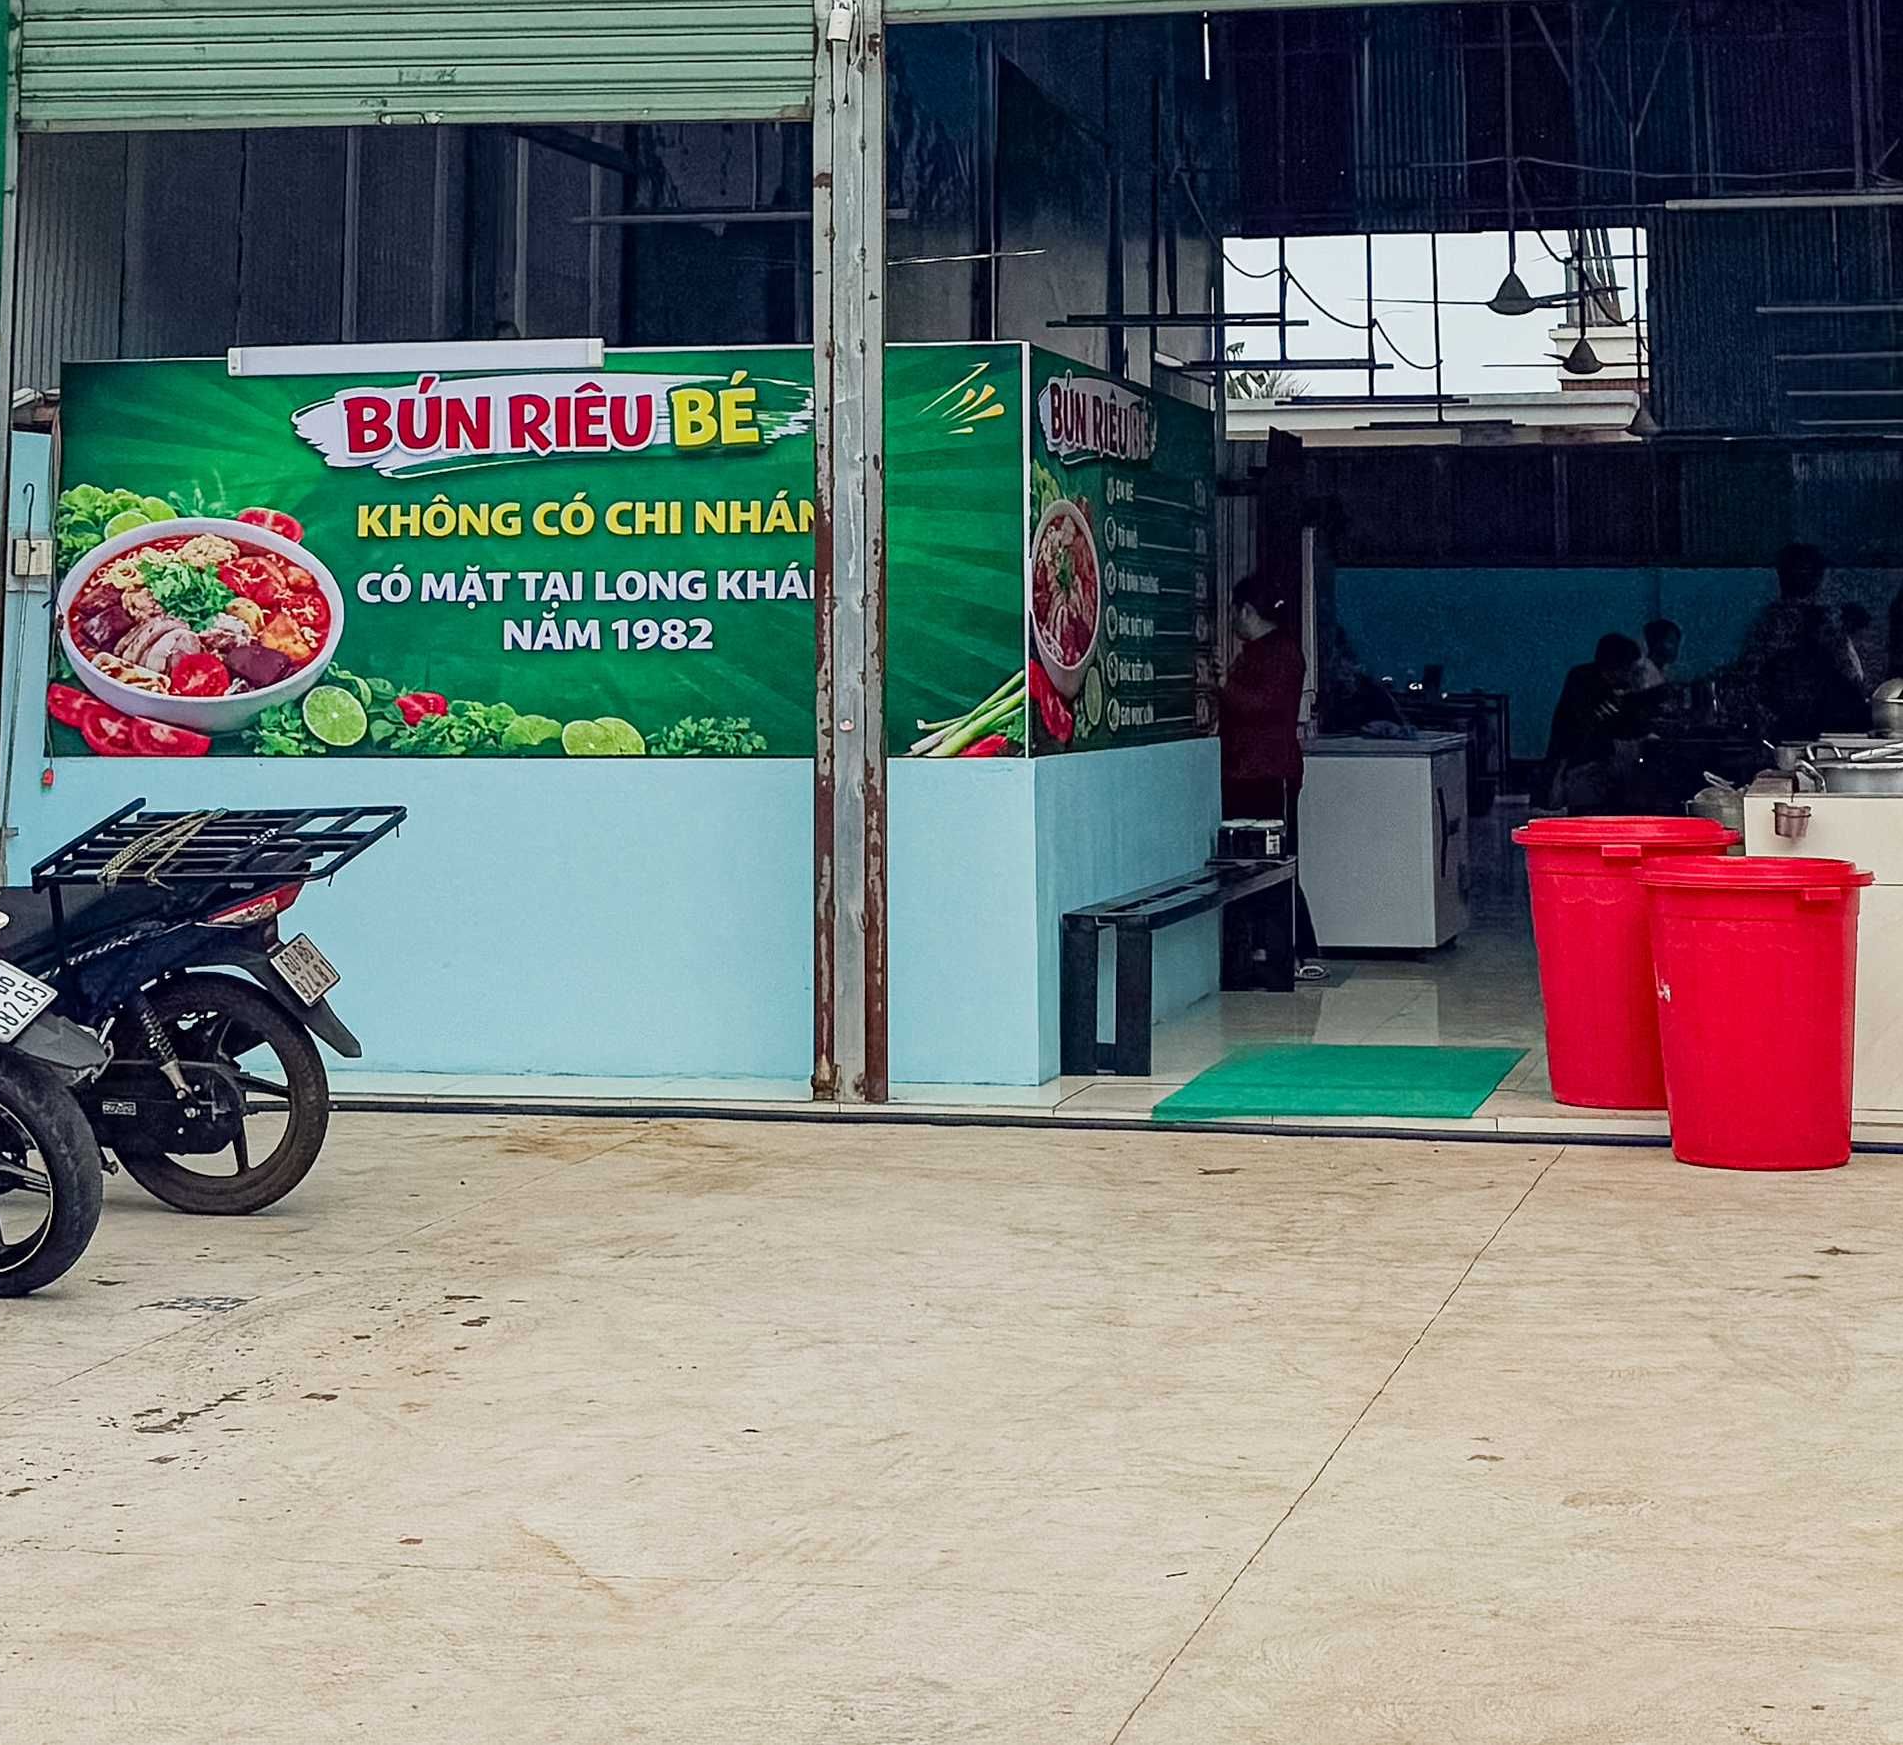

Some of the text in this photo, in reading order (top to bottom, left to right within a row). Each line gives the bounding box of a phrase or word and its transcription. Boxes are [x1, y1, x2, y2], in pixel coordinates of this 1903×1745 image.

[345, 370, 760, 454] BÚN RIÊU BÉ
[1049, 369, 1087, 445] BÚN
[1092, 389, 1128, 458] RIÊU
[356, 493, 523, 538] KHÔNG
[533, 489, 597, 537] CÓ
[605, 502, 684, 536] CHI
[356, 562, 415, 603] CÓ
[420, 563, 512, 611] MẶT
[517, 571, 586, 610] TẠI
[594, 569, 708, 602] LONG
[503, 609, 714, 652] NĂM 1982
